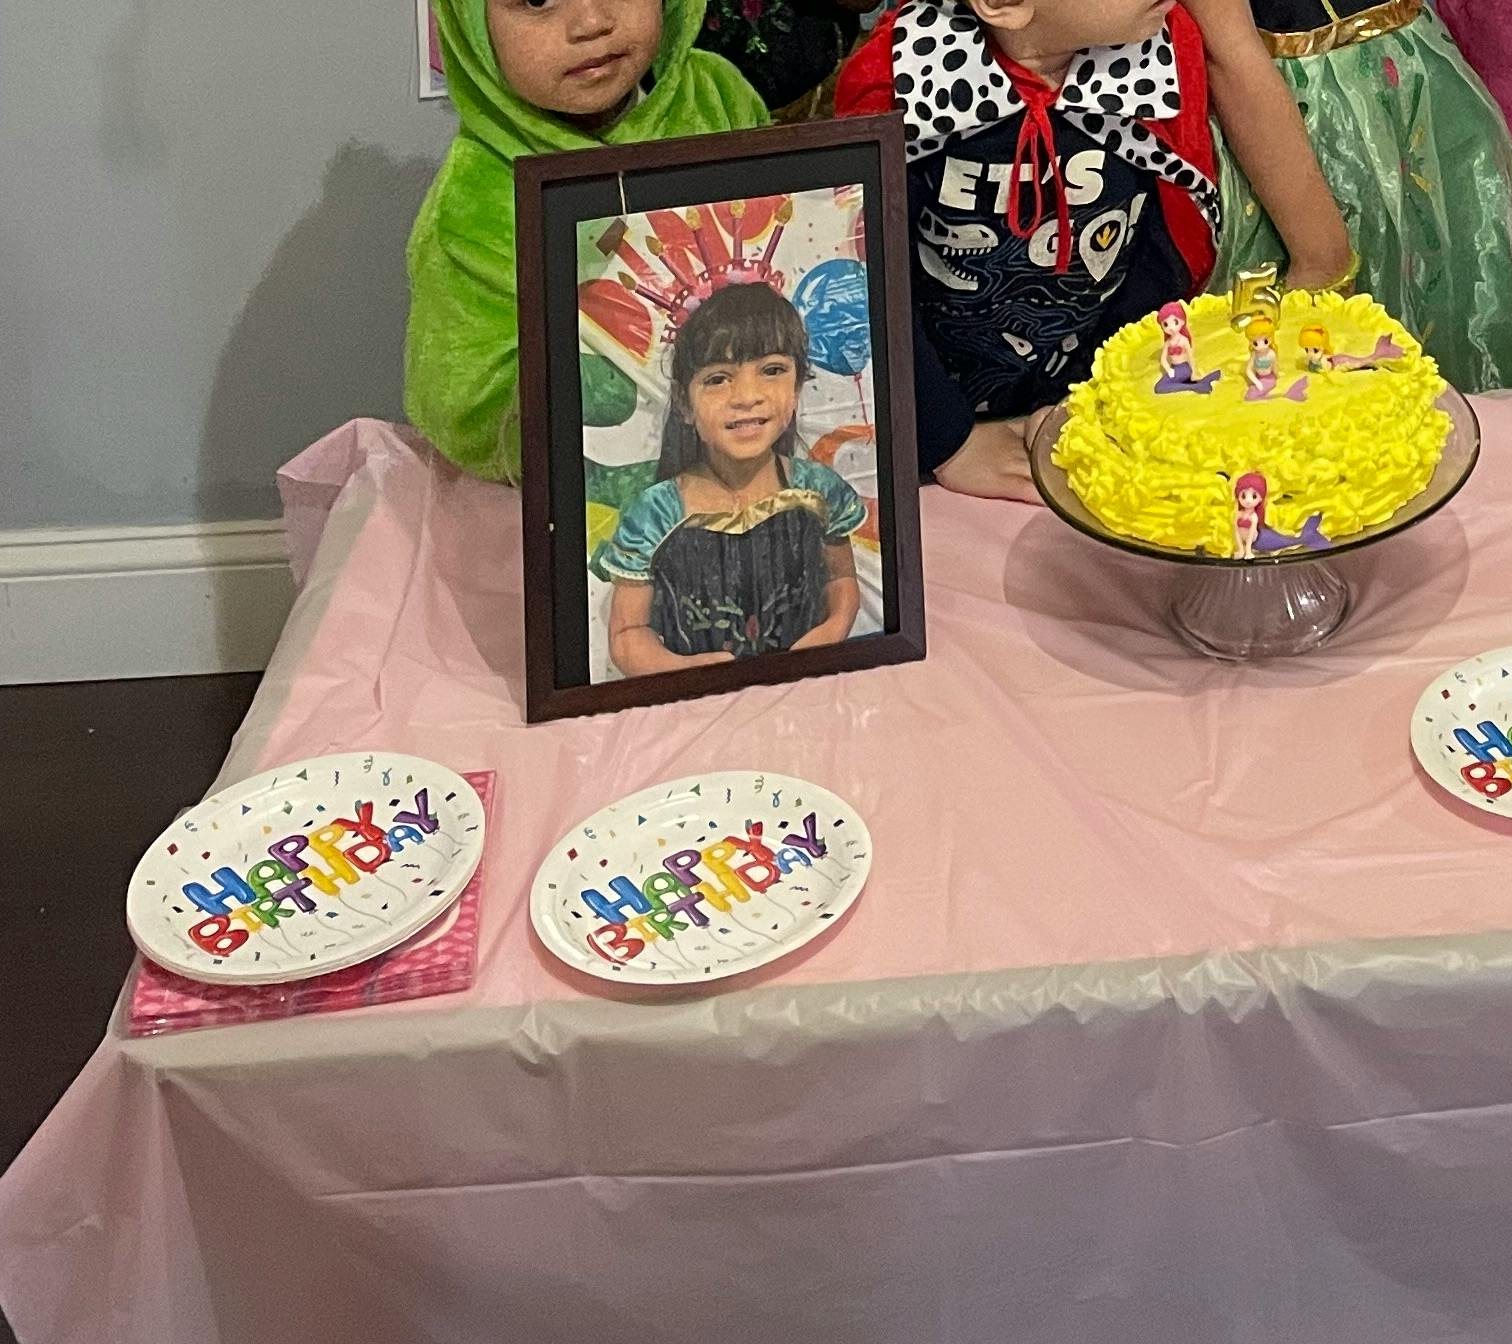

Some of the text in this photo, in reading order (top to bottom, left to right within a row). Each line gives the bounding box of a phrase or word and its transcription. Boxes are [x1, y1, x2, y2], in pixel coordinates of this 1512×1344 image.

[182, 801, 387, 917] HAPPY
[188, 788, 440, 956] BIRTHDAY
[581, 821, 776, 924] HAPPY
[587, 812, 827, 965] BIRTHDAY
